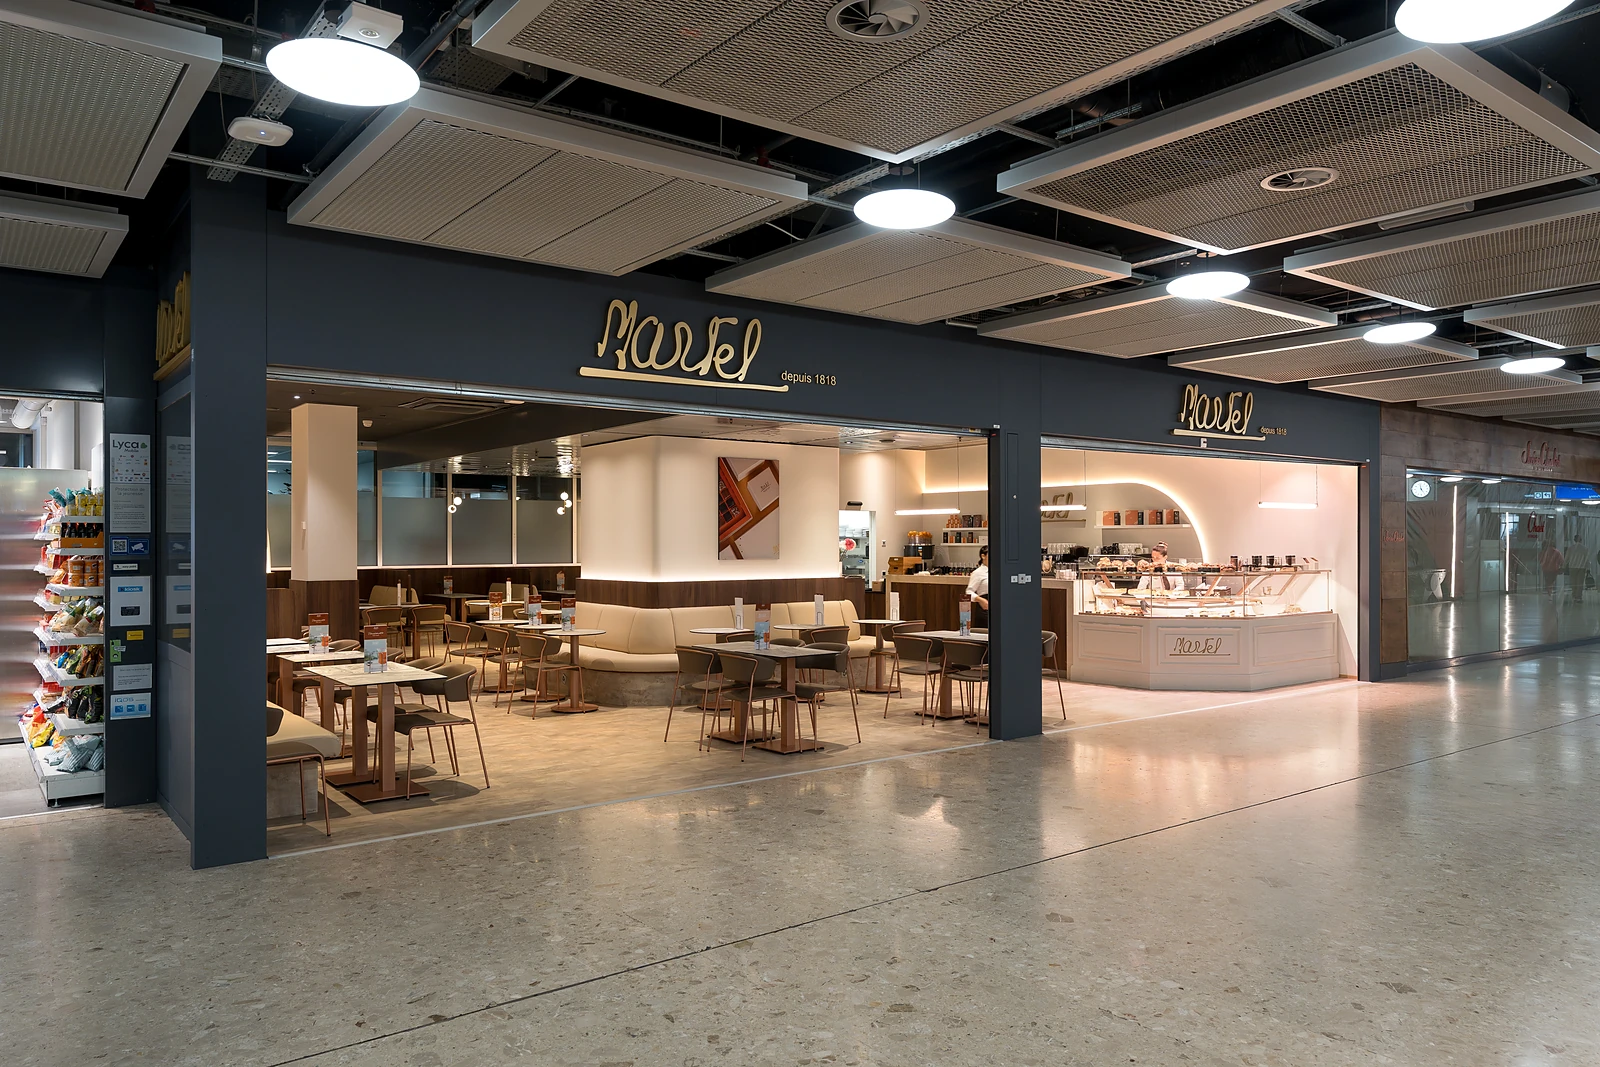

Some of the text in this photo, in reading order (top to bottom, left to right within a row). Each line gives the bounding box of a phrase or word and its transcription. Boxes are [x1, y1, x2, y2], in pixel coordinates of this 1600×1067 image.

[597, 299, 762, 382] Martel
[781, 370, 837, 386] depuis 1818
[1179, 384, 1254, 435] Martel
[112, 439, 139, 450] Lyca
[1173, 637, 1222, 654] Martel
